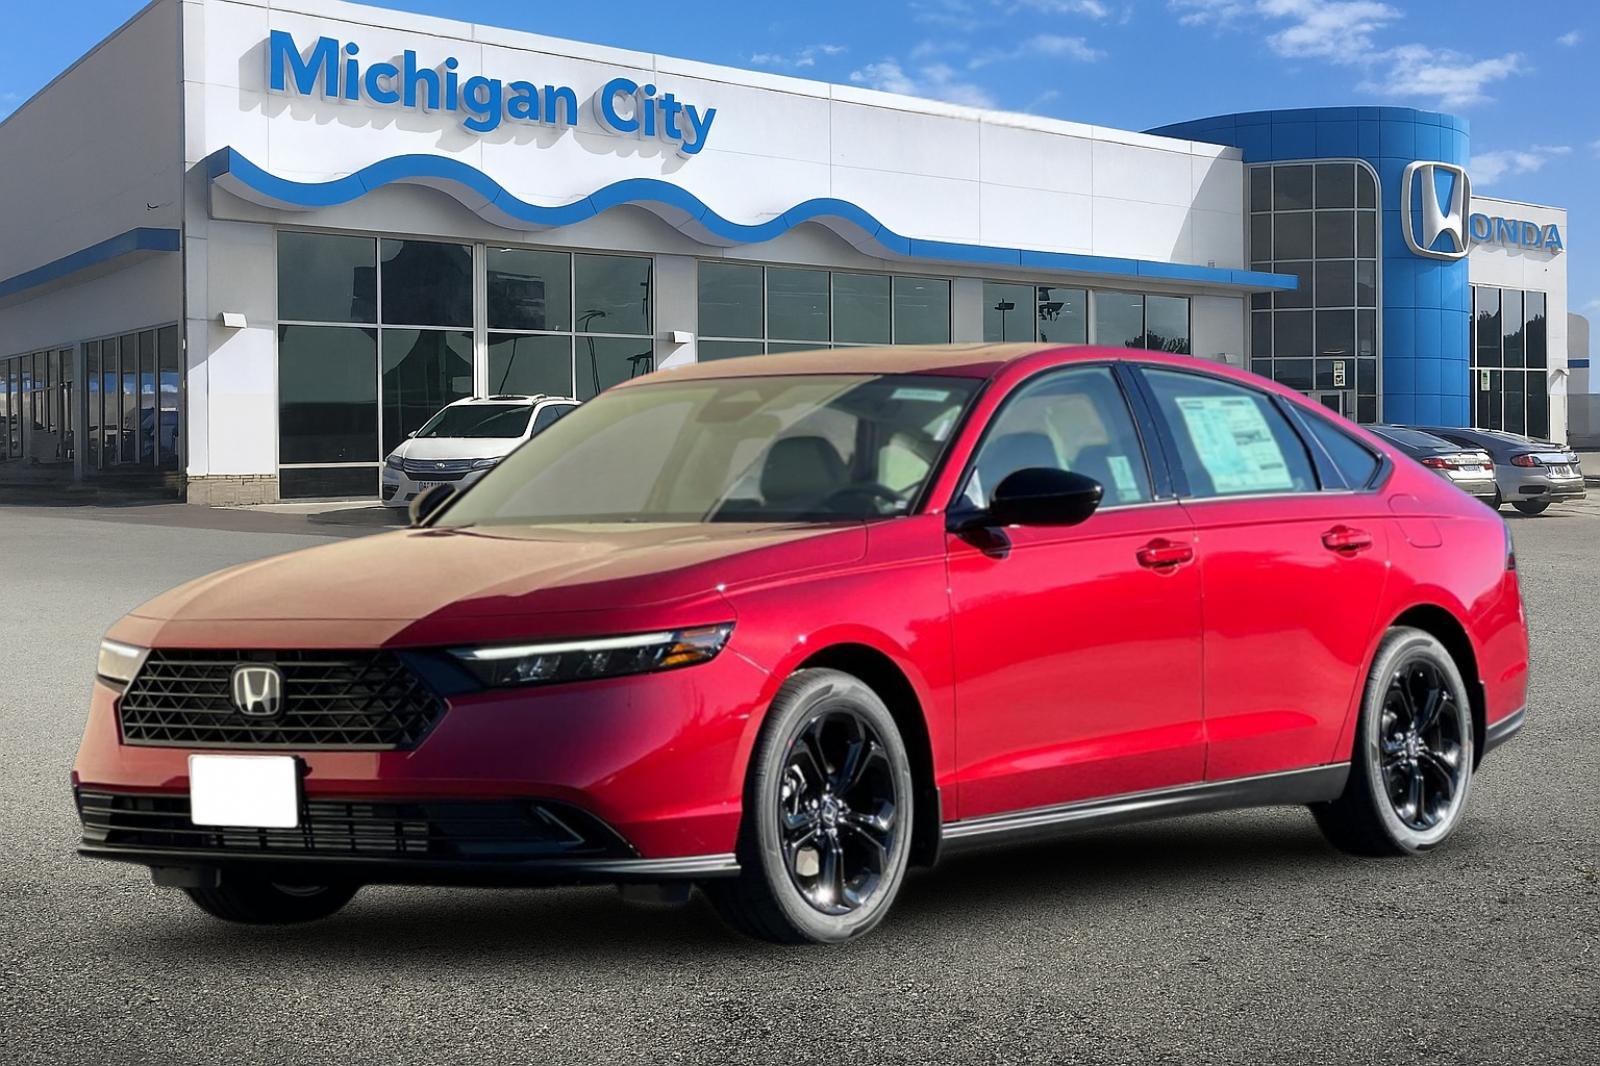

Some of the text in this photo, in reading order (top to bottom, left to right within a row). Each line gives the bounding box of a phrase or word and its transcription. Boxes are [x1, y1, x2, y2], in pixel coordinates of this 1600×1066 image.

[269, 30, 717, 154] Michigan City
[1470, 213, 1563, 251] ONDA
